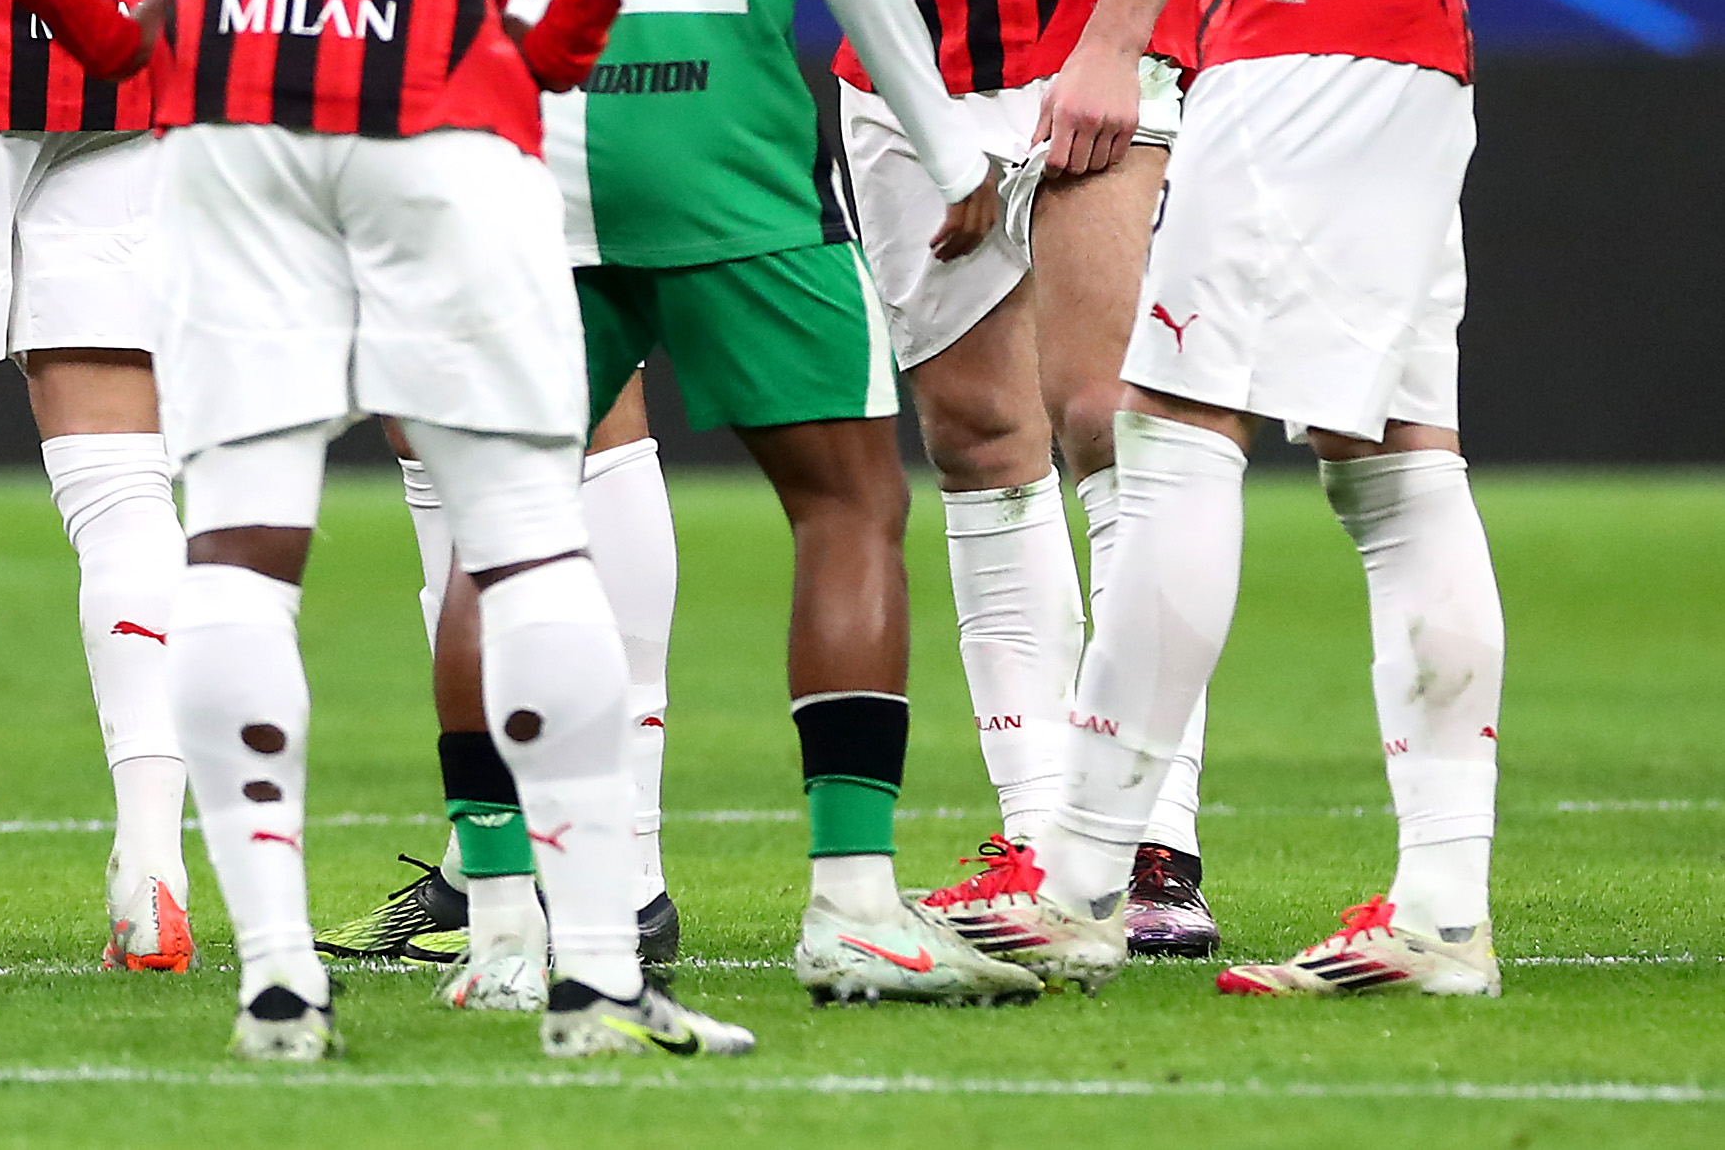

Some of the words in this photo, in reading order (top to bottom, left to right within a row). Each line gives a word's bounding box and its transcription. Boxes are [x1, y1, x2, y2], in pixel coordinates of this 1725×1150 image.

[582, 60, 710, 94] DATION
[975, 715, 1021, 731] LAN
[1068, 710, 1120, 737] LAN
